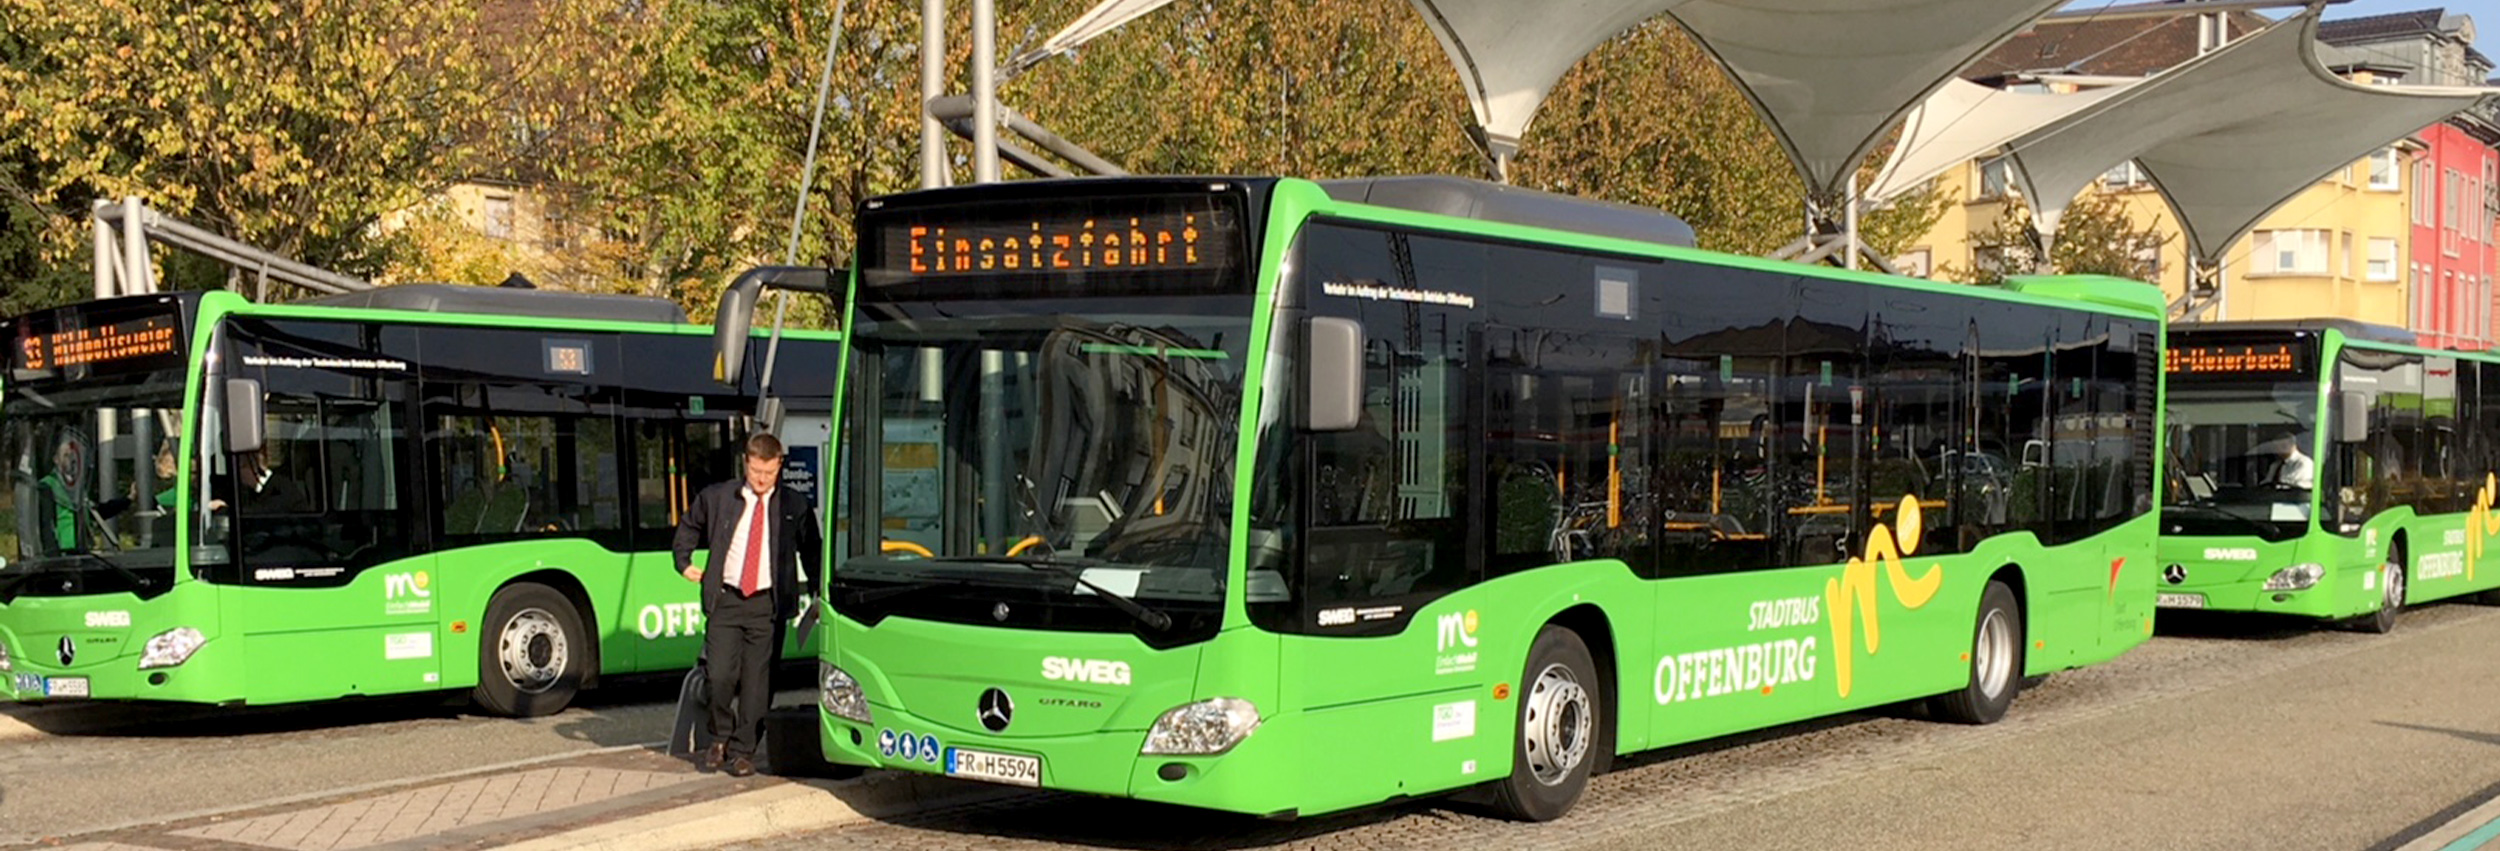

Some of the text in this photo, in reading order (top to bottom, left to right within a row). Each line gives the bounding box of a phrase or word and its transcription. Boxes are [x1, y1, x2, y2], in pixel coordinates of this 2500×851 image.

[909, 215, 1200, 274] Einsatzfahrt
[84, 610, 132, 628] SWEG
[1317, 607, 1356, 627] SWEG
[1747, 595, 1820, 631] STADTBUS
[1041, 655, 1132, 686] SWEG
[1654, 636, 1817, 705] OFFENBURG
[1038, 697, 1102, 709] CITARO
[956, 752, 976, 772] FR
